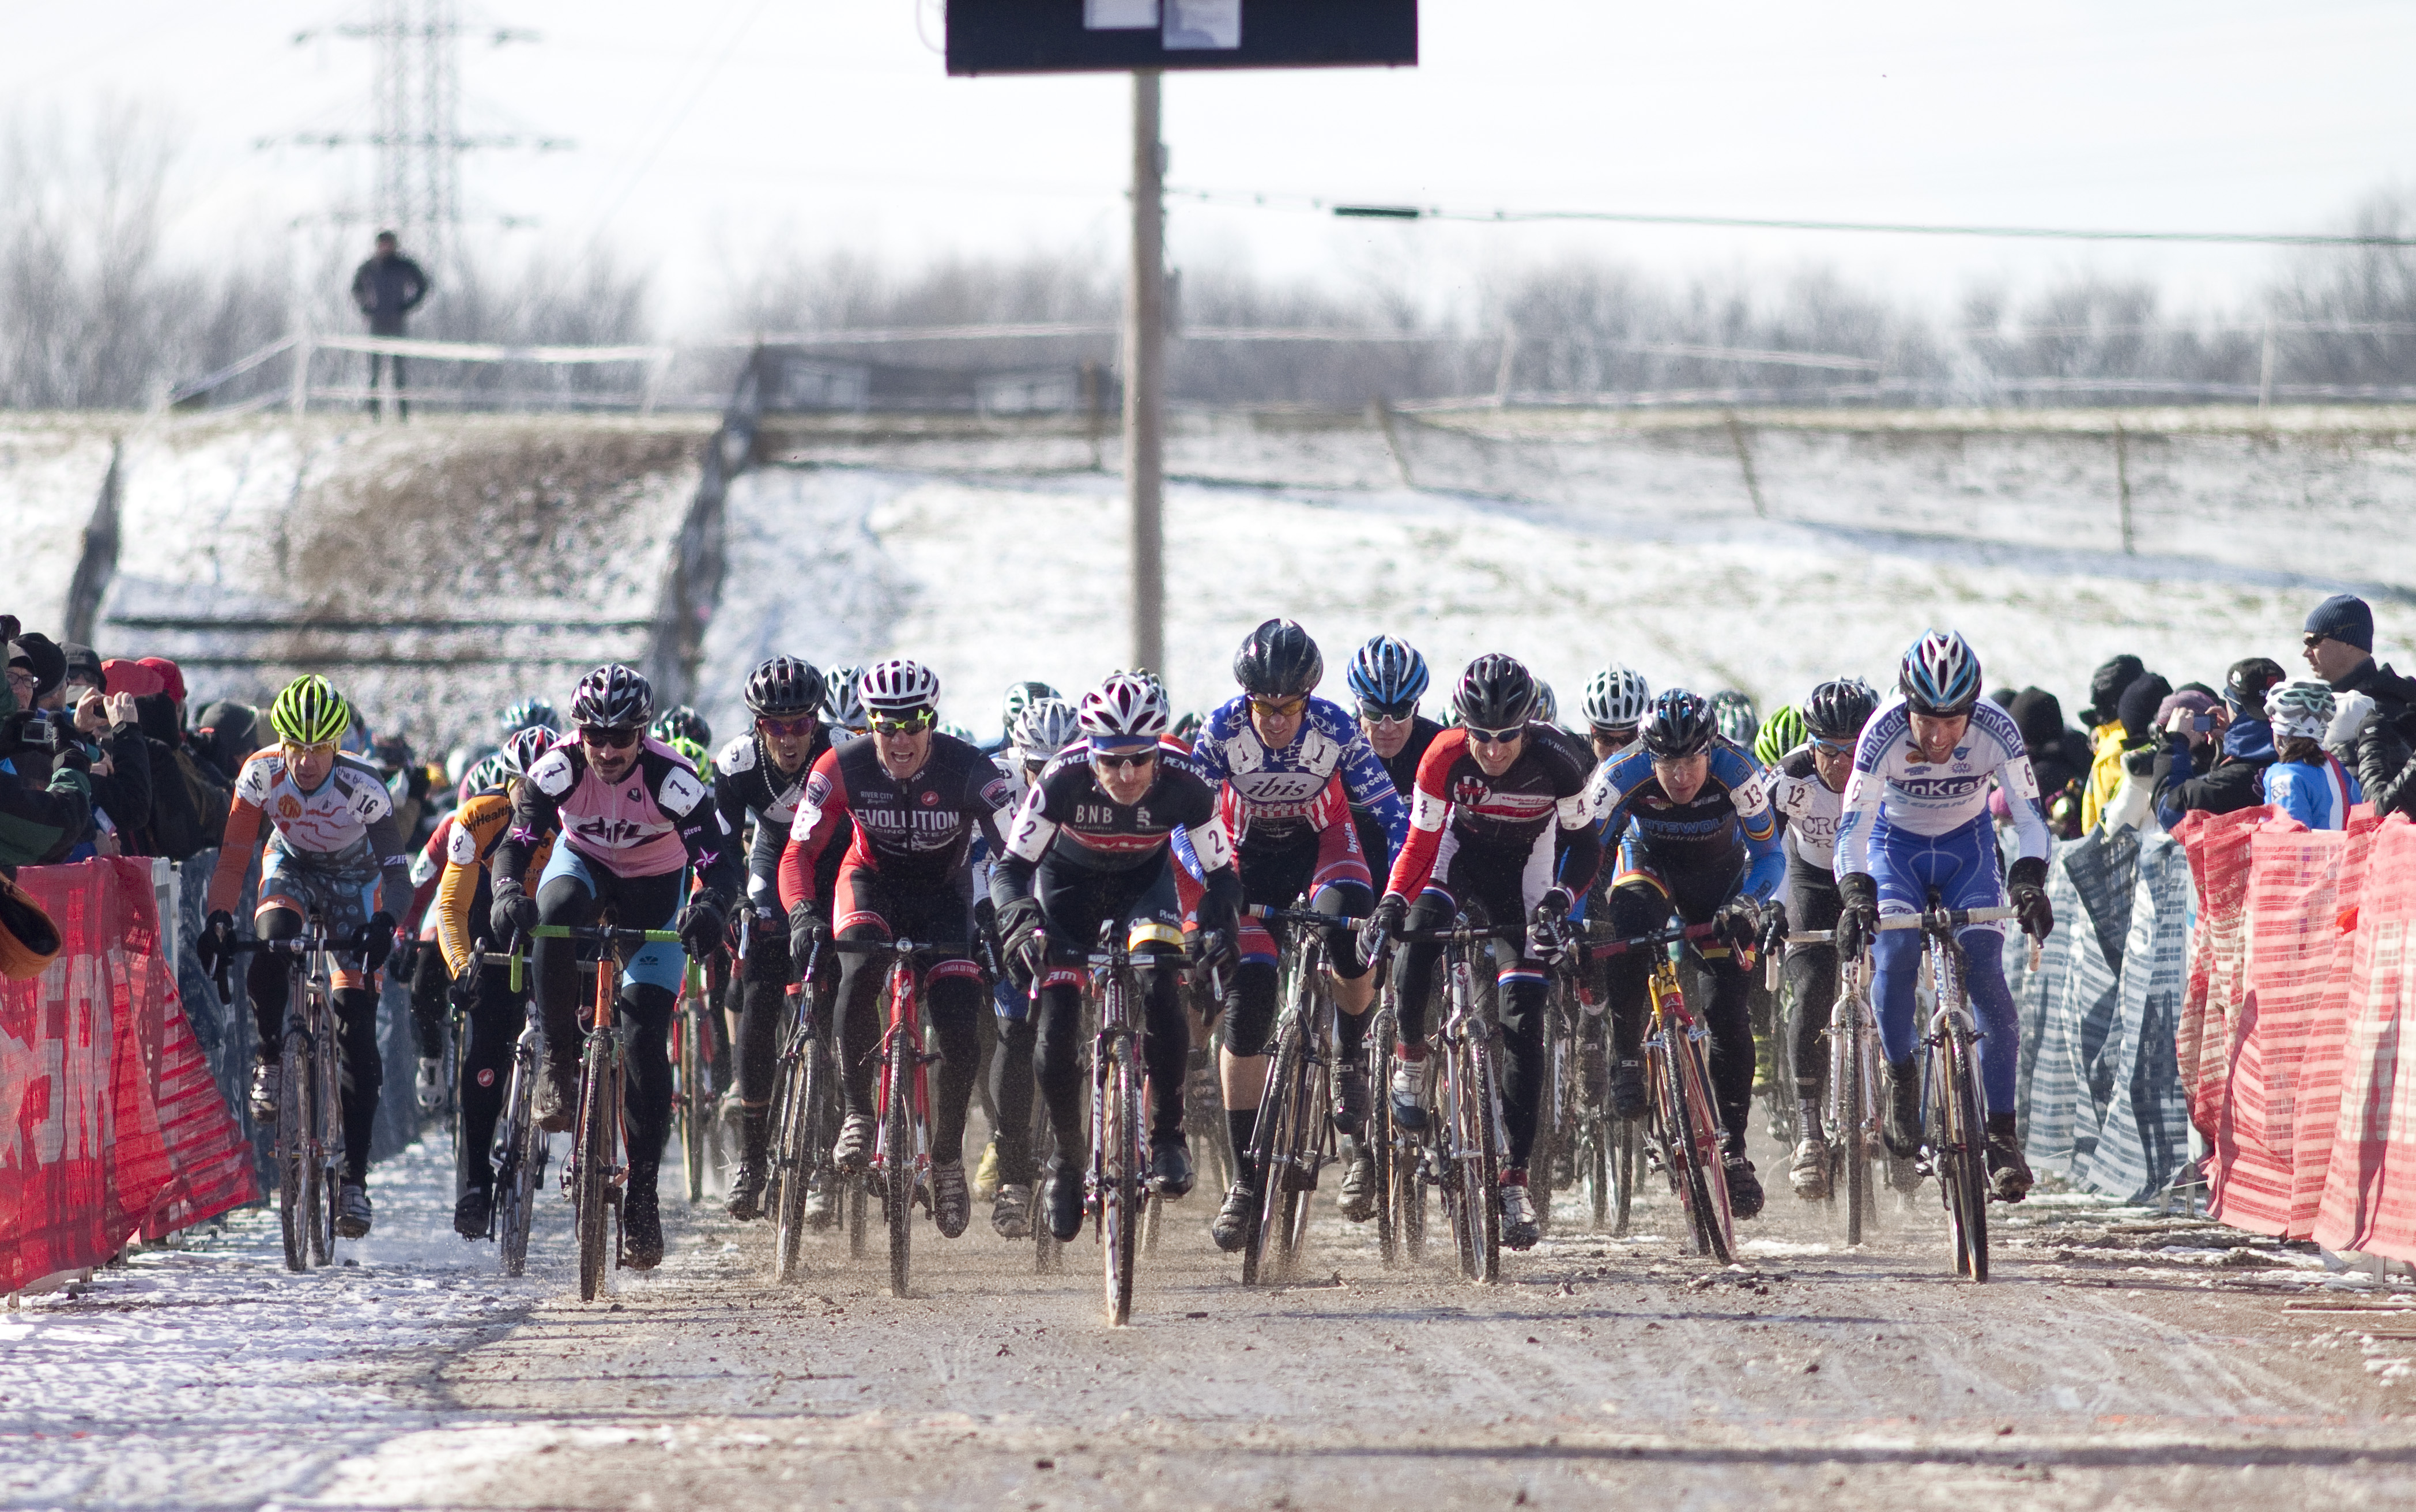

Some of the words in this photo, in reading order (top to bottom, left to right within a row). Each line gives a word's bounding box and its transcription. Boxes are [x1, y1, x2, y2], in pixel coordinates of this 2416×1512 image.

[1858, 709, 1905, 766] FinKraft
[1974, 705, 2023, 755] FinKraft
[730, 745, 740, 762] 9
[1238, 742, 1249, 762] 1
[1312, 744, 1326, 764] 1
[544, 762, 566, 779] 7
[911, 770, 925, 782] PDX
[2024, 763, 2034, 787] 6
[247, 771, 263, 793] 16
[669, 779, 691, 797] 7
[1246, 776, 1307, 797] ibis
[1852, 779, 1863, 802] 6
[356, 794, 378, 816] 16
[1743, 783, 1763, 809] 13
[1787, 785, 1805, 808] 12
[1075, 805, 1113, 824] BNB
[1420, 800, 1428, 819] 4
[1577, 798, 1586, 816] 4
[854, 809, 960, 831] EVOLUTION
[684, 825, 702, 839] Stevo
[1019, 820, 1036, 844] 2
[1208, 830, 1224, 854] 2
[453, 836, 463, 853] 8
[940, 965, 959, 974] BANDA
